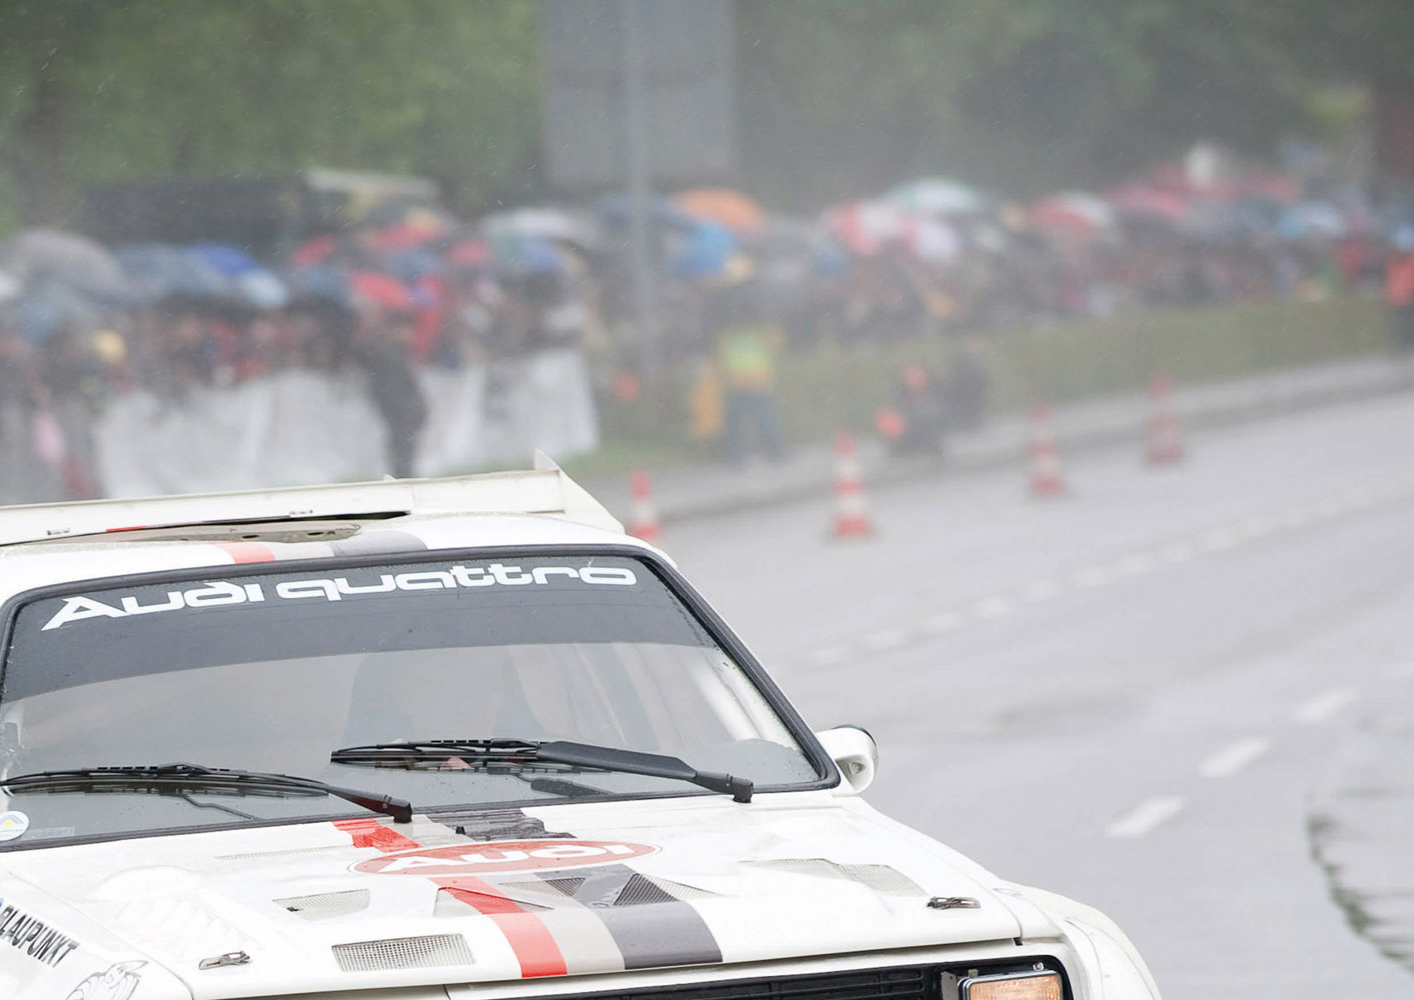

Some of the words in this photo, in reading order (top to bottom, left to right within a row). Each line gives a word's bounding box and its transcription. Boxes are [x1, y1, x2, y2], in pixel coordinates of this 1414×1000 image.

[41, 579, 265, 631] Audi
[277, 562, 637, 601] quattro
[376, 844, 637, 872] Audi
